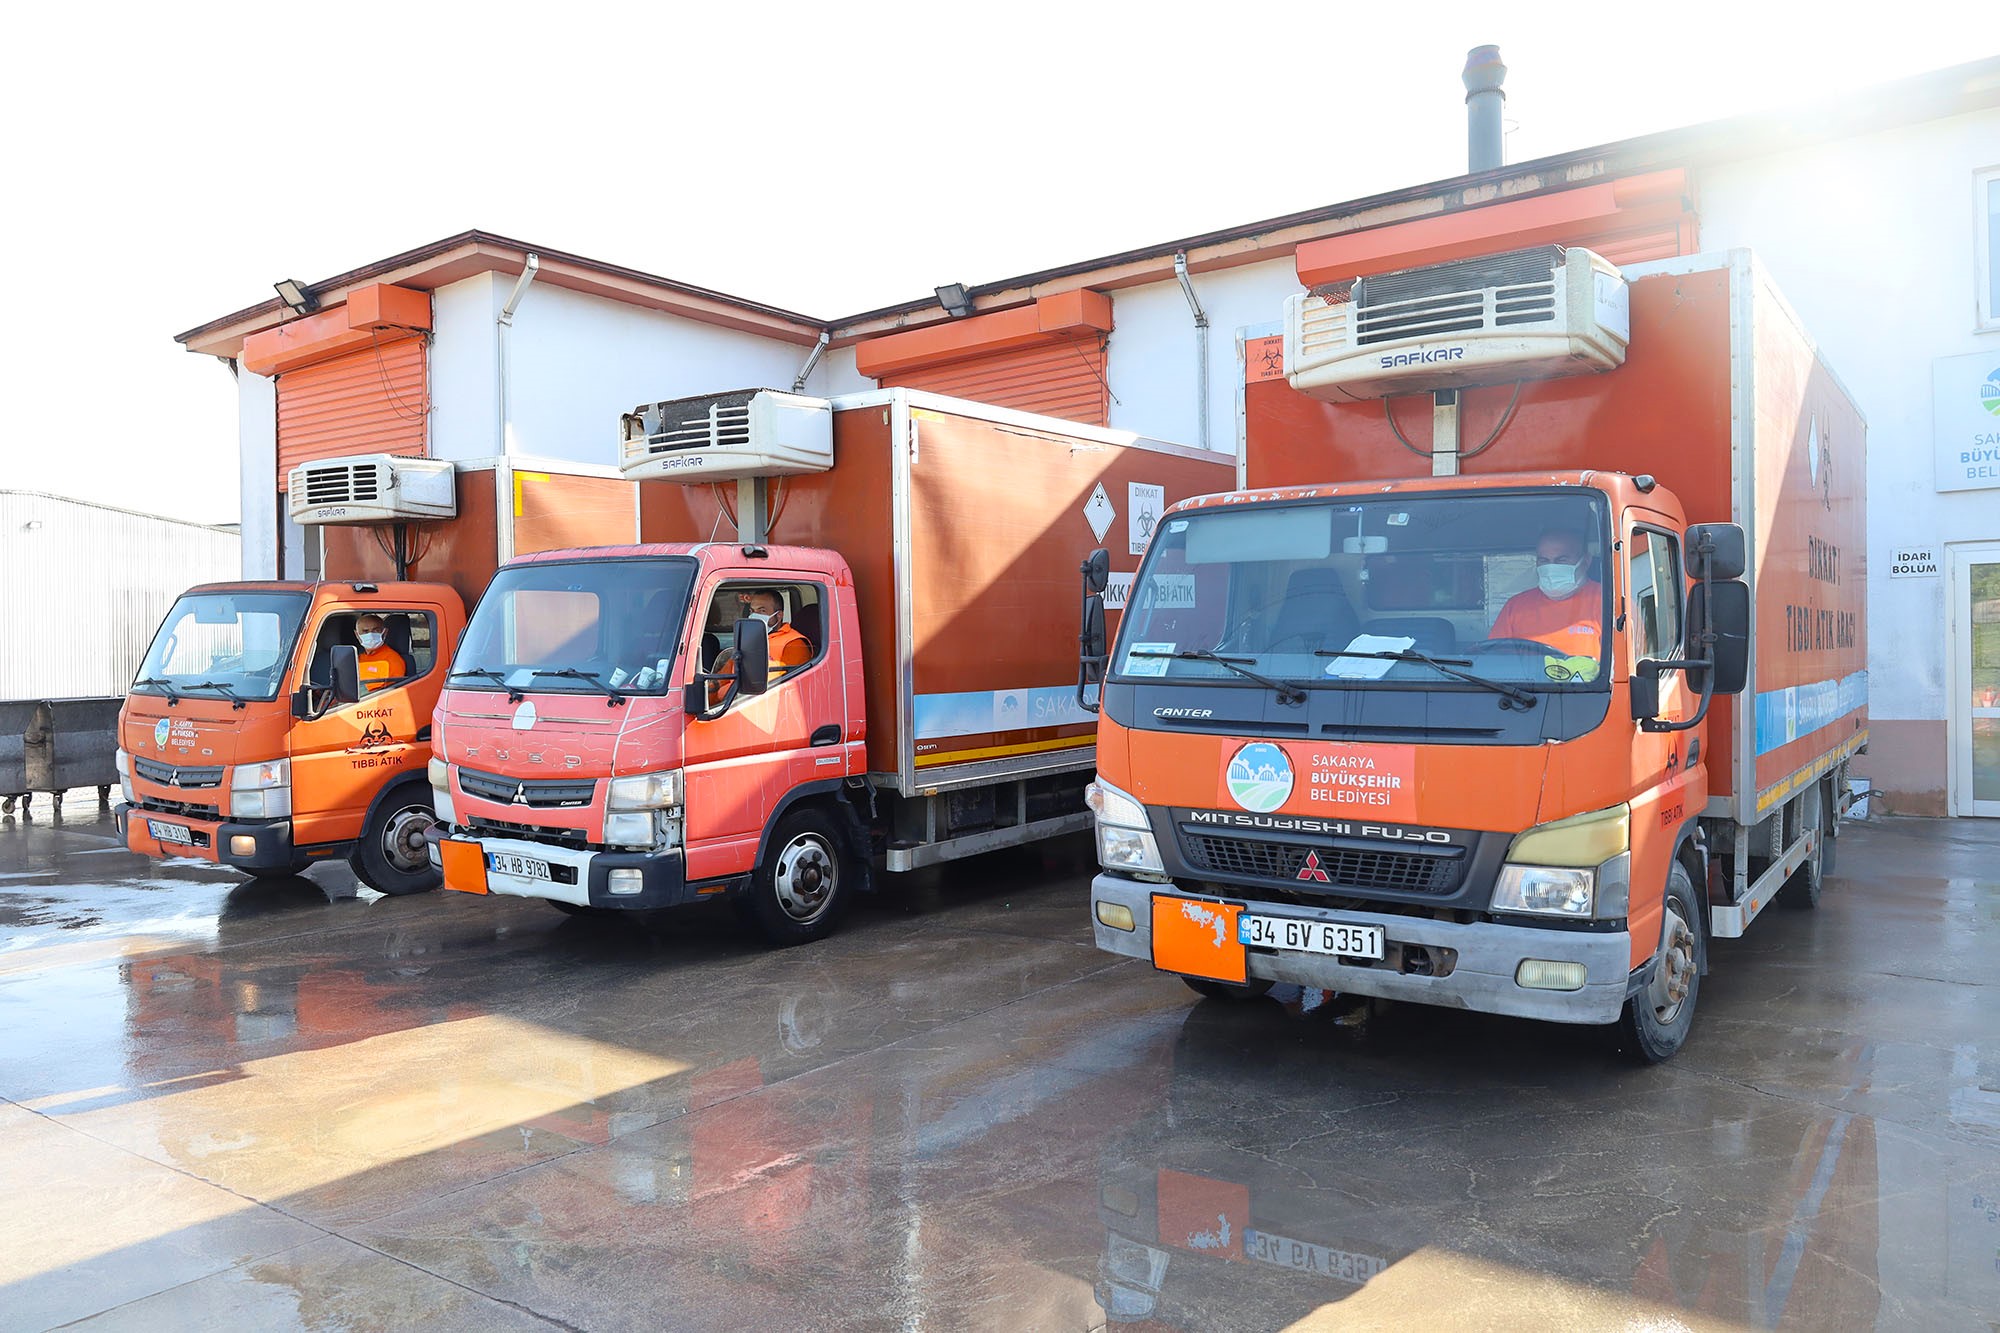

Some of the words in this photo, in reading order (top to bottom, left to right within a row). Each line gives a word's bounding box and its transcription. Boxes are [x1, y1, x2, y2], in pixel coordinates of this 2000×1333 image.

[1381, 347, 1464, 369] SAFKAR
[662, 457, 703, 470] SAFKAR
[1967, 465, 2000, 479] BEL
[1898, 550, 1931, 561] İDARİ
[1892, 562, 1937, 574] BÖLÜM
[1153, 707, 1213, 718] CANTER
[380, 756, 403, 766] ATIK
[1312, 754, 1375, 770] SAKARYA
[1311, 769, 1401, 789] BÜYÜKŞEHİR
[1311, 788, 1391, 806] BELEDİYESİ
[495, 855, 507, 871] 34
[511, 857, 523, 873] HB
[525, 860, 549, 878] 9782
[1252, 919, 1275, 944] 34
[1286, 923, 1312, 948] GV
[1323, 927, 1375, 954] 6351
